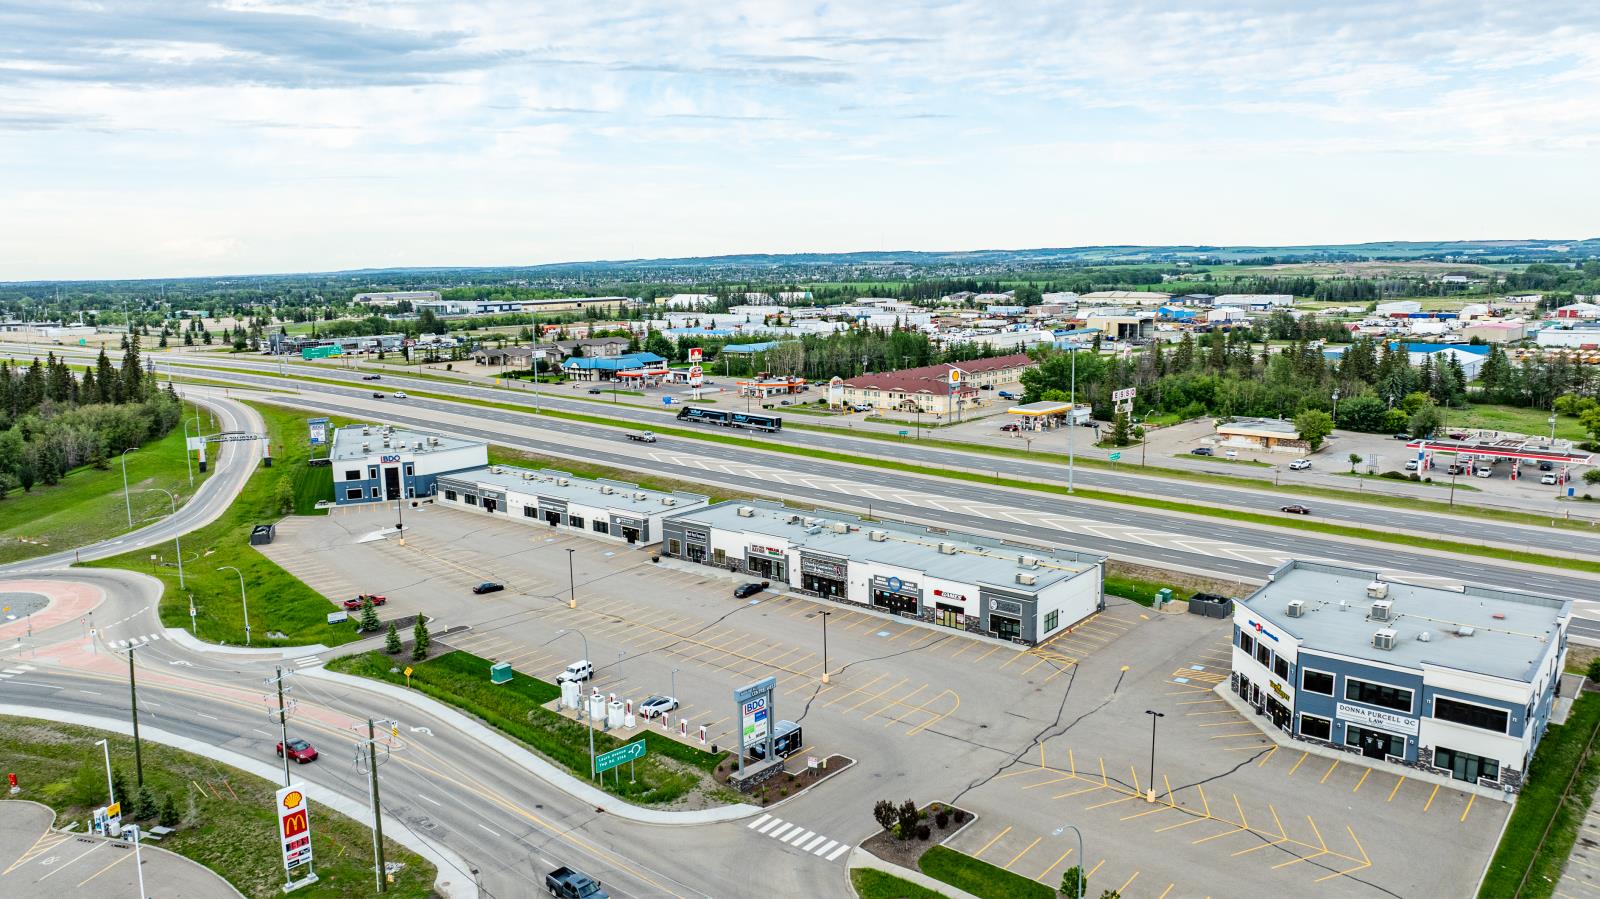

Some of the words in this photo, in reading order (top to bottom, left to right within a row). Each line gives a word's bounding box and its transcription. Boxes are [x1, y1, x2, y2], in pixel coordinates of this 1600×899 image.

[1115, 388, 1135, 398] ESSO
[383, 454, 401, 462] BDO
[746, 698, 765, 712] BDO
[1339, 704, 1366, 716] DONNA
[1367, 710, 1401, 724] PURCELL
[1403, 718, 1416, 727] QC
[1368, 717, 1384, 725] LAW
